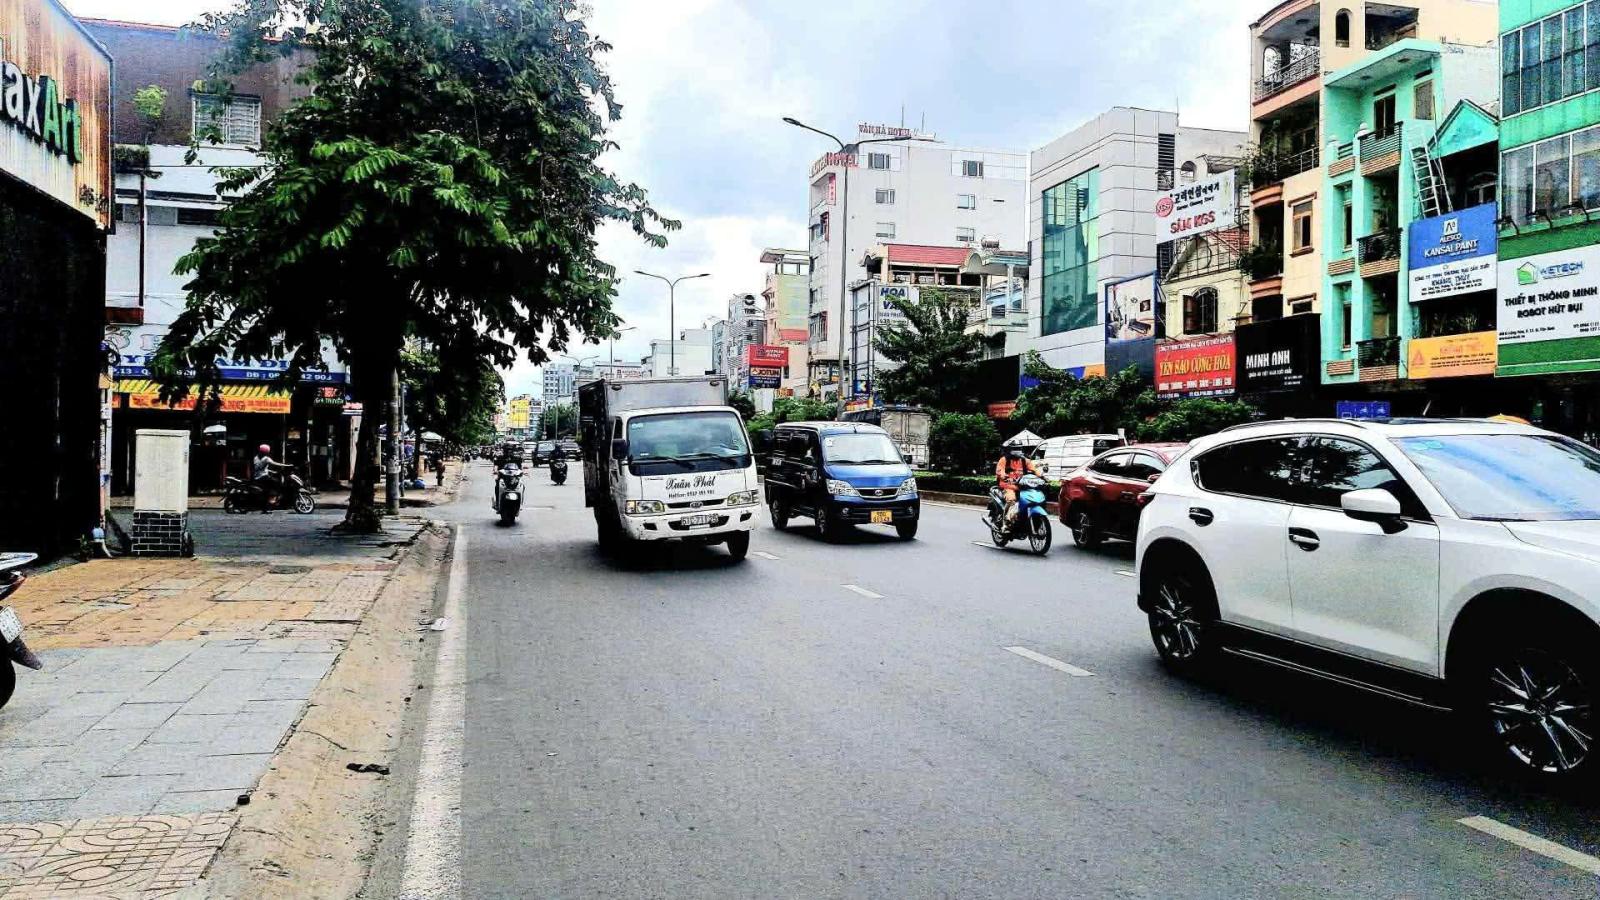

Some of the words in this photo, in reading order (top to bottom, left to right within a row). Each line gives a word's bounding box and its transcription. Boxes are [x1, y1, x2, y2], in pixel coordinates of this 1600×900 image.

[0, 60, 82, 163] axArt
[1194, 210, 1216, 227] KGS
[1440, 234, 1462, 243] ALESCO
[1424, 244, 1453, 258] KANSAI
[1456, 240, 1478, 252] PAINT
[1504, 292, 1526, 306] THIẾT
[1528, 295, 1536, 304] BỊ
[1538, 290, 1570, 302] THÔNG
[1572, 286, 1598, 297] MINH
[1517, 307, 1547, 318] ROBOT
[1548, 304, 1566, 314] HÚT
[1568, 302, 1583, 314] BỤI
[1246, 353, 1270, 369] MINH
[1272, 349, 1290, 366] ANH
[693, 475, 716, 488] Phát
